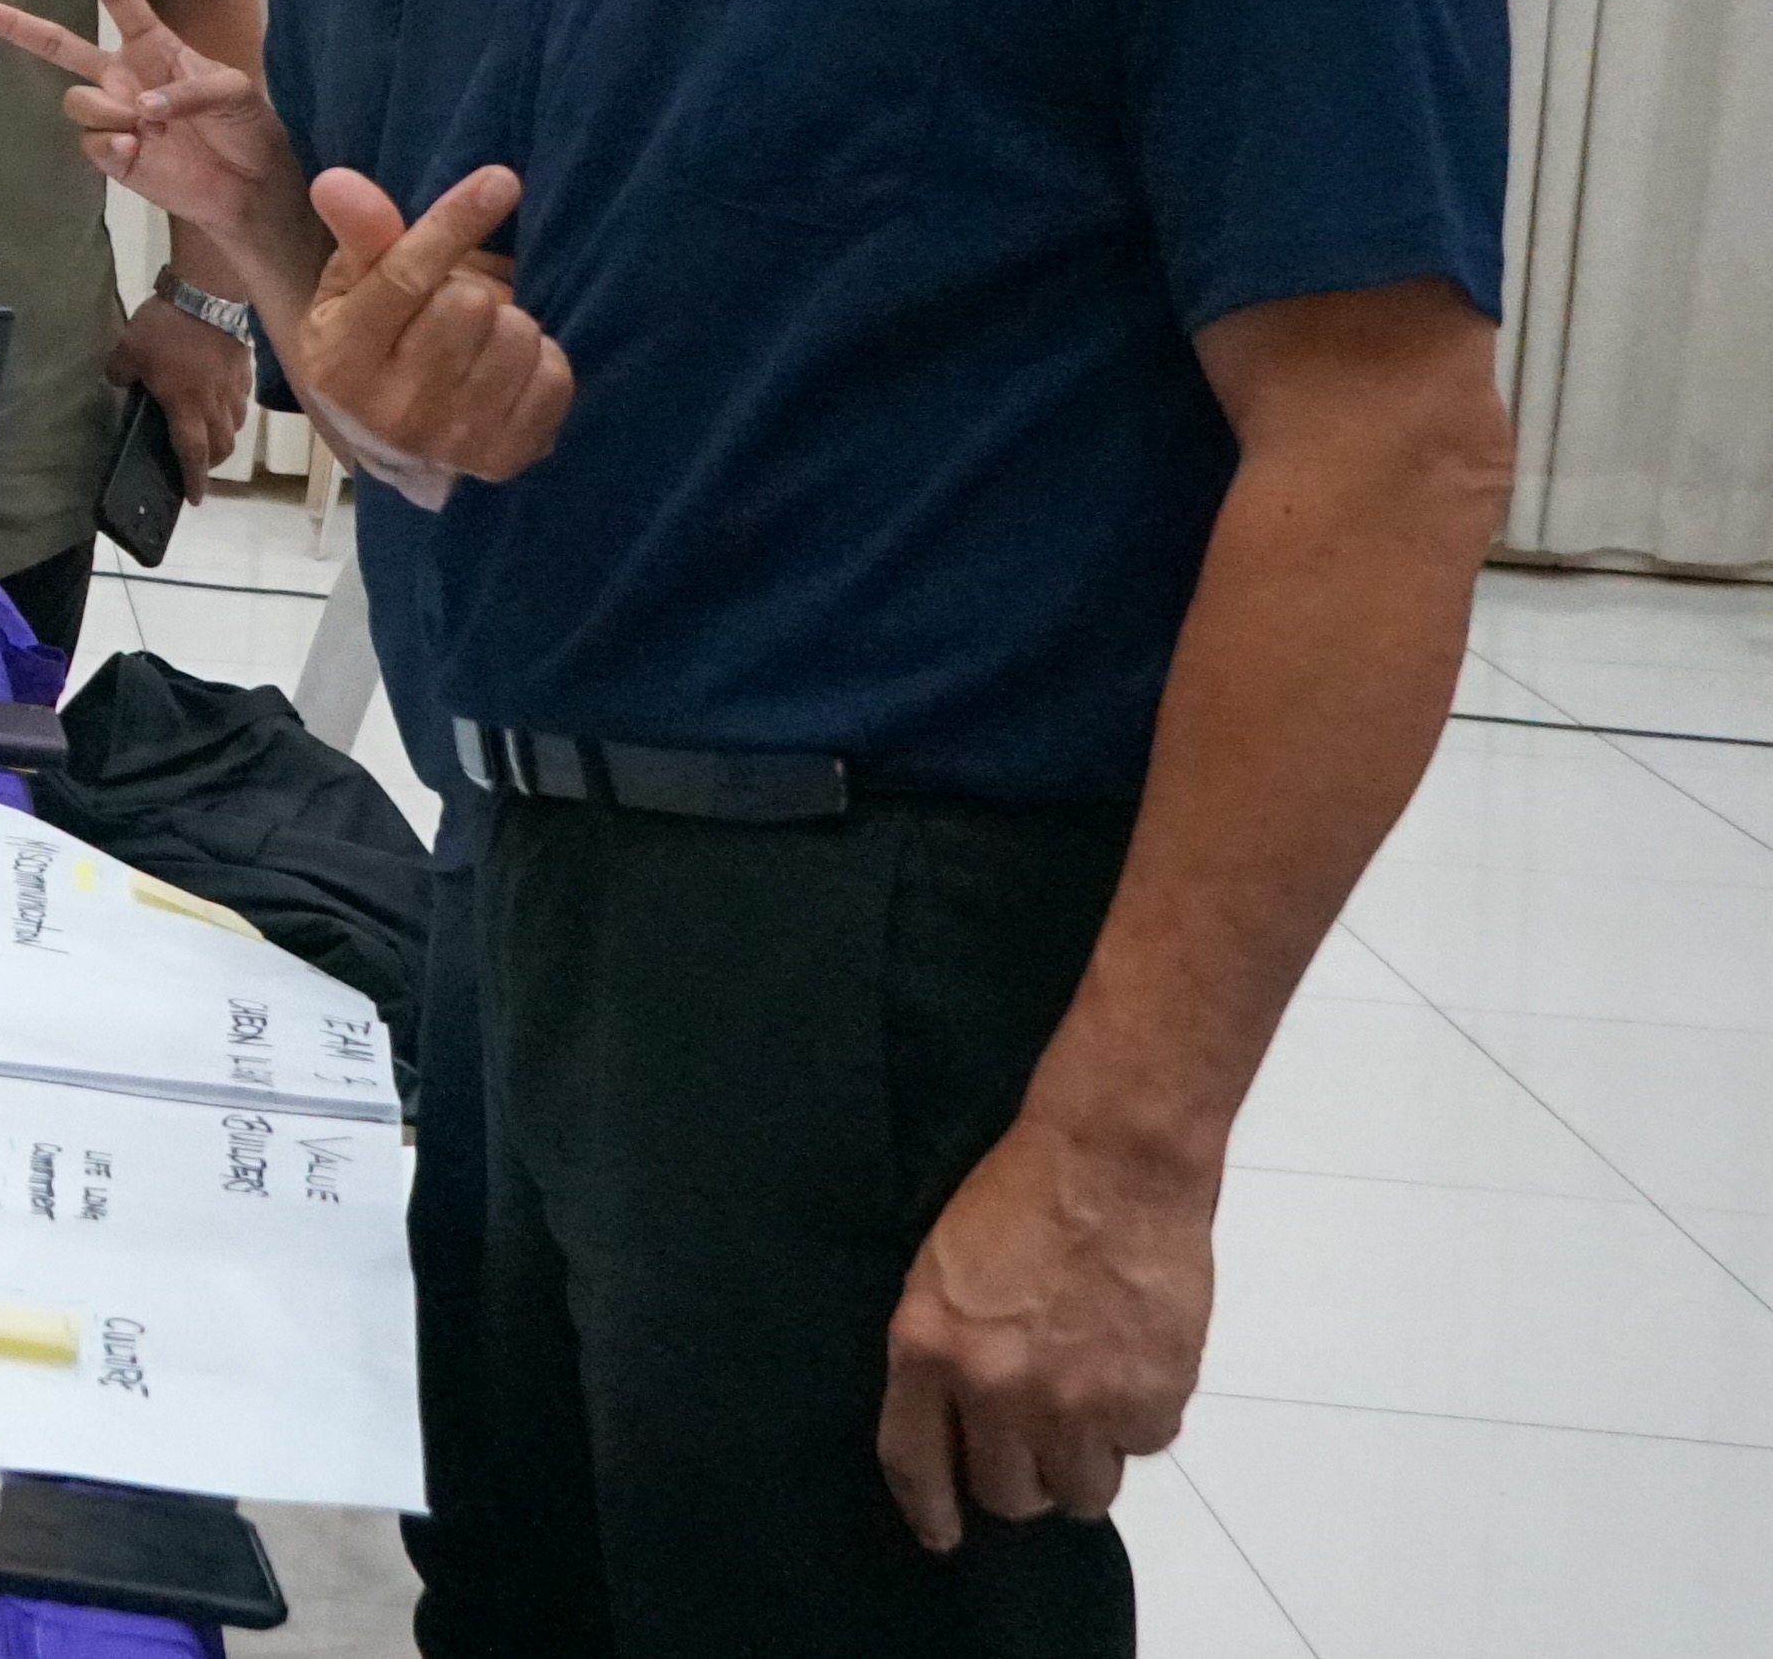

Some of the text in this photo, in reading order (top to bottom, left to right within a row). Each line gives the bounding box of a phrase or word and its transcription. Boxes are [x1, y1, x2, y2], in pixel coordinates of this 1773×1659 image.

[226, 997, 273, 1047] CHEON
[84, 1149, 112, 1179] LIFE
[220, 1113, 273, 1197] BUILDERS
[295, 1135, 354, 1205] VALUE
[98, 1317, 149, 1398] CULTURE
